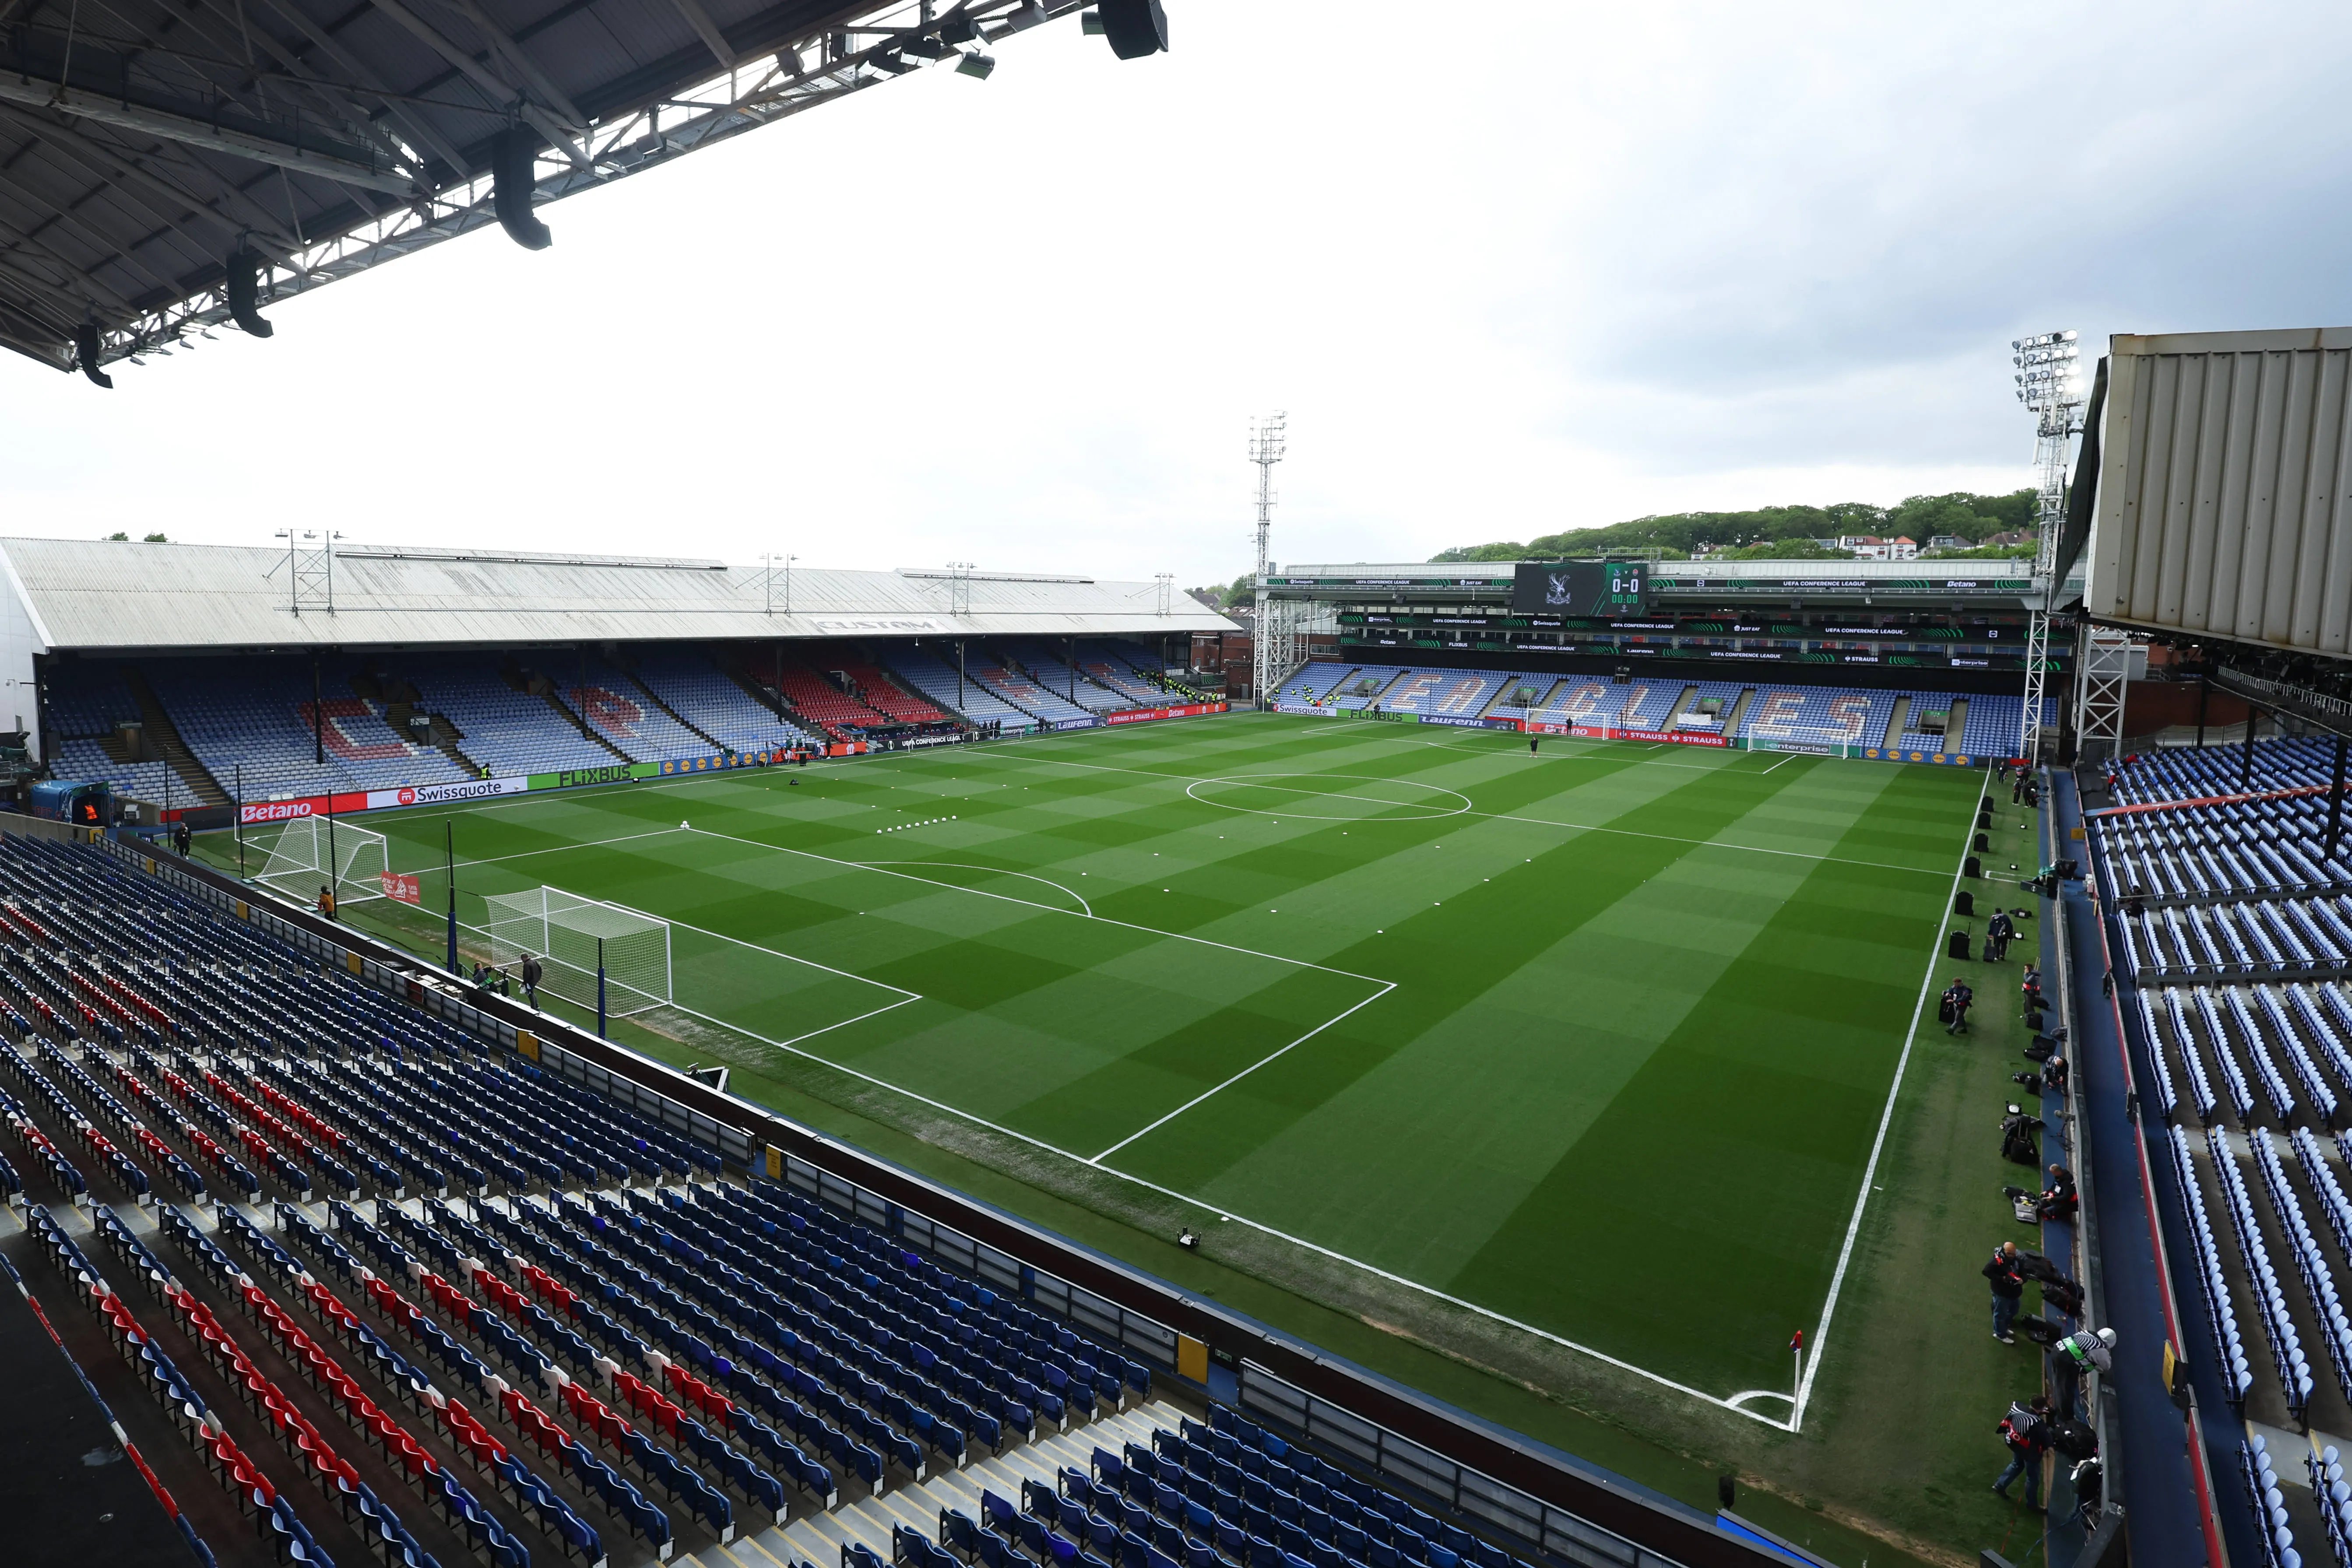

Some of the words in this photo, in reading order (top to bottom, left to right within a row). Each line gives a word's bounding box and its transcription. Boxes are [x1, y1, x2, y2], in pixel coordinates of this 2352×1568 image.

[1613, 579, 1638, 593] 0-0
[1612, 594, 1638, 604] 00:00
[1280, 705, 1328, 715] Swissquote
[1631, 732, 1668, 740] STRAUSS
[1683, 736, 1723, 744] STRAUSS
[1767, 742, 1828, 752] enterprise
[417, 781, 502, 803] Swissquote
[242, 802, 311, 823] Betano
